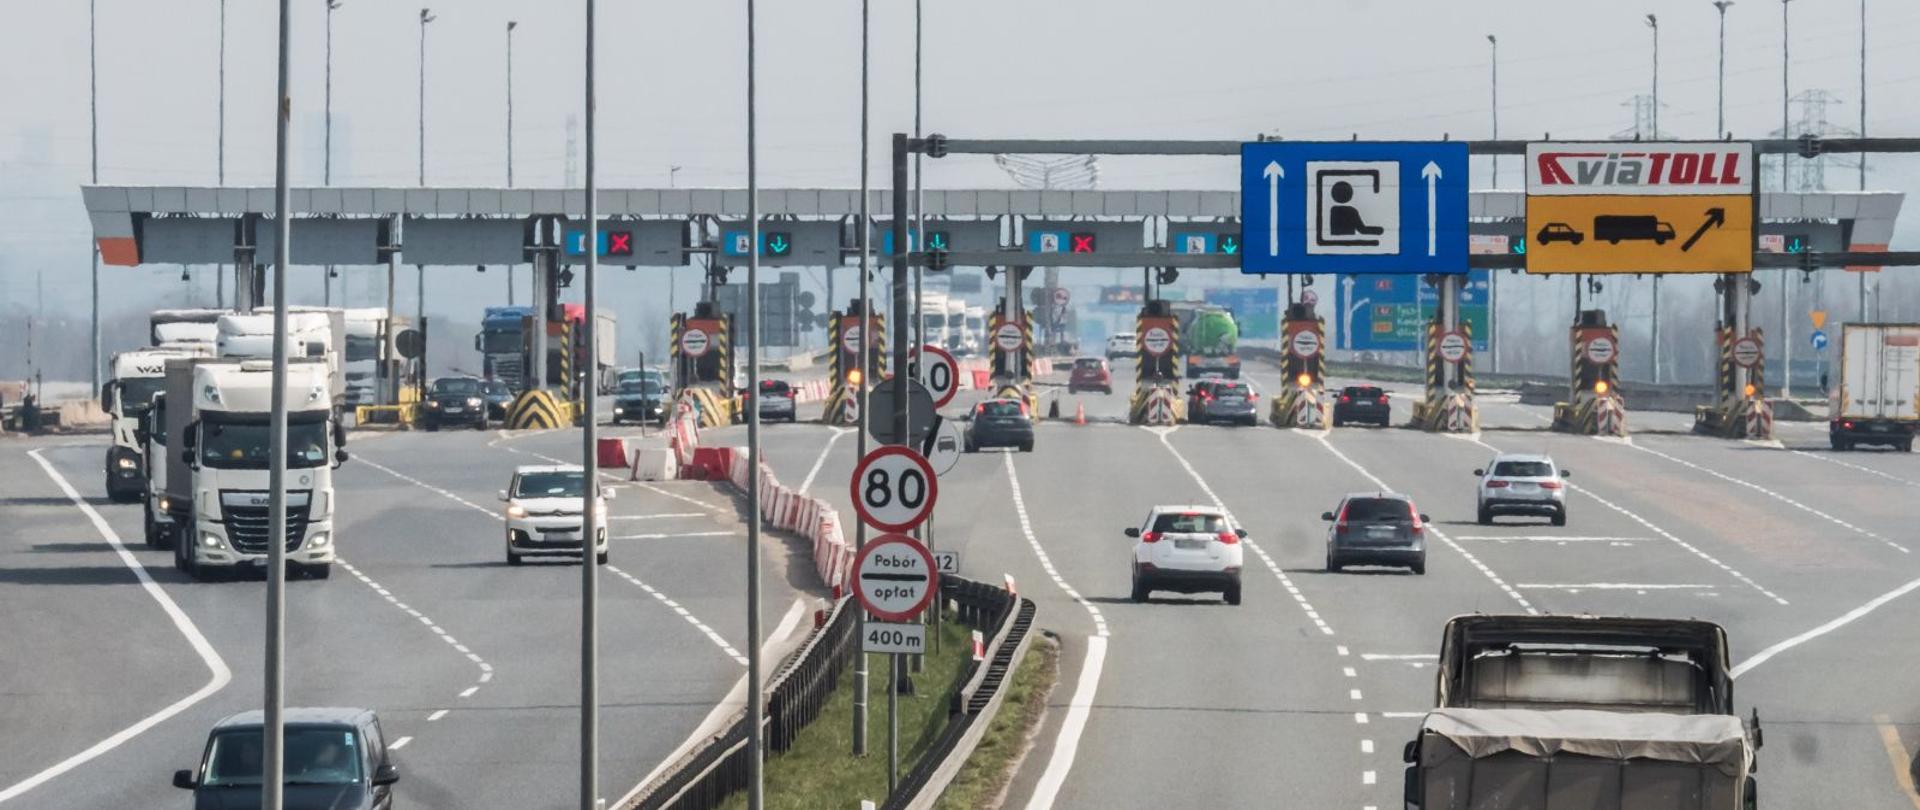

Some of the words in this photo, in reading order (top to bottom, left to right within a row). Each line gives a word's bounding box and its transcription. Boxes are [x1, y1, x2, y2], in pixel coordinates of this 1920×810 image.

[1577, 153, 1741, 185] viaTOLL
[865, 468, 926, 509] 80
[874, 554, 916, 568] Pobór
[935, 555, 953, 570] 12
[874, 586, 916, 601] opłat
[868, 630, 903, 646] 400
[906, 636, 920, 647] m
